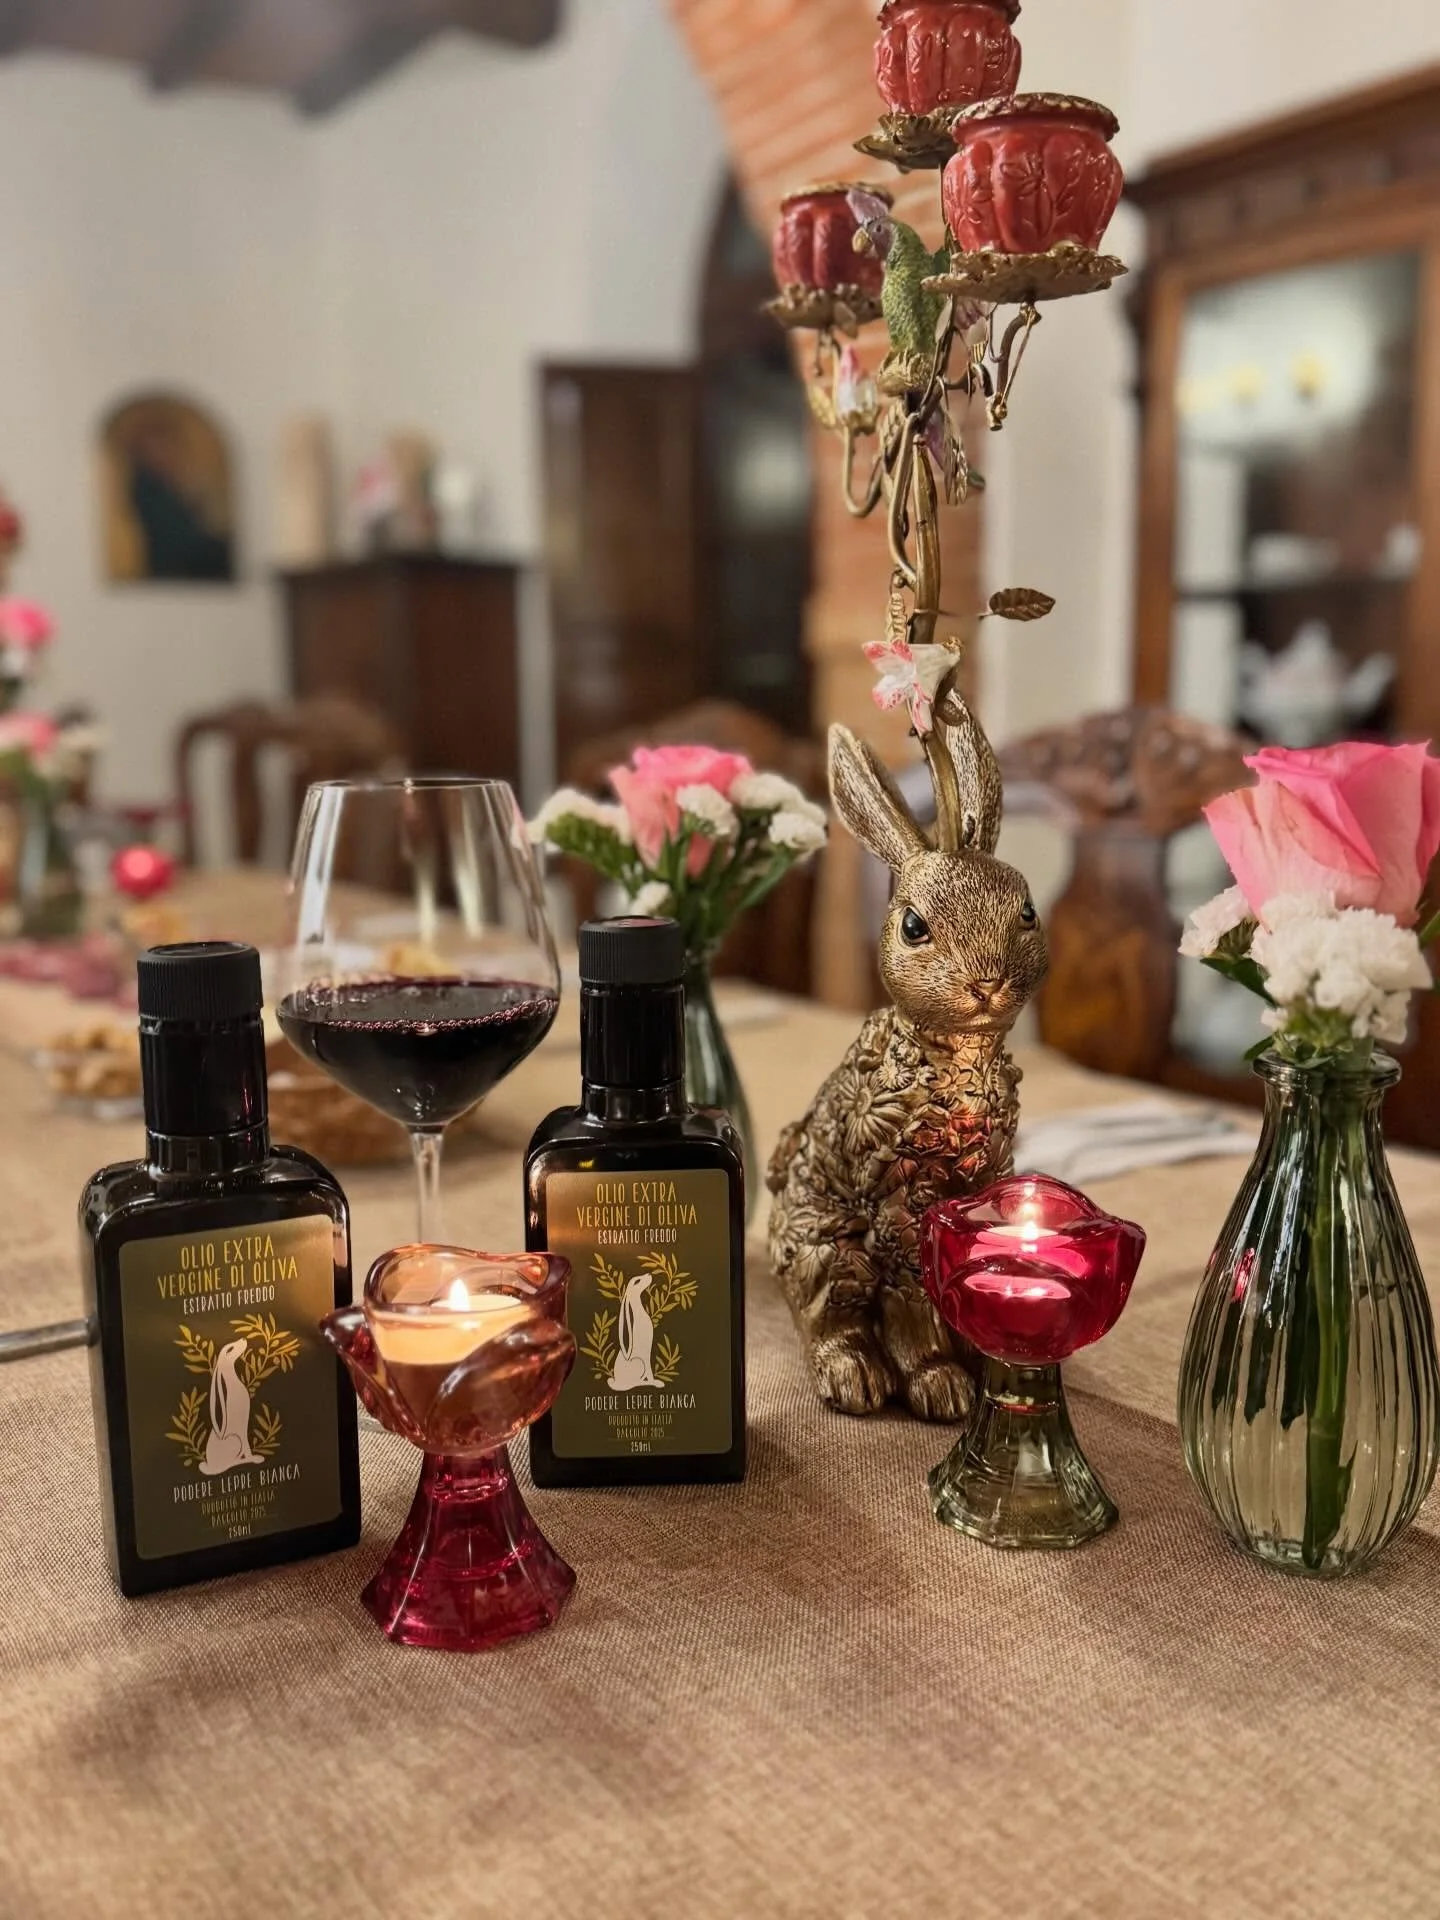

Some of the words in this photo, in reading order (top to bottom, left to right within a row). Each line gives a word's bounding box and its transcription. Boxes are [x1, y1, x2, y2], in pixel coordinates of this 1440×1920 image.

[596, 1182, 625, 1204] OLIO
[633, 1181, 677, 1203] EXTRA
[576, 1205, 631, 1228] VERGINE
[638, 1205, 651, 1226] DI
[658, 1203, 697, 1226] OLIVA
[598, 1229, 640, 1245] ESTRATTO
[644, 1228, 677, 1243] FREDDO
[181, 1242, 215, 1270] OLIO
[224, 1234, 274, 1264] EXTRA
[157, 1267, 222, 1299] VERGINE
[230, 1264, 245, 1288] DI
[253, 1255, 298, 1285] OLIVA
[183, 1291, 232, 1315] ESTRATTO
[237, 1284, 275, 1307] FREDDO
[585, 1395, 618, 1412] PODERE
[626, 1394, 653, 1410] LEPRE
[660, 1393, 696, 1409] BIANCA
[173, 1480, 213, 1503] PODERE
[221, 1473, 252, 1494] LEPRE
[260, 1463, 301, 1485] BIANCA
